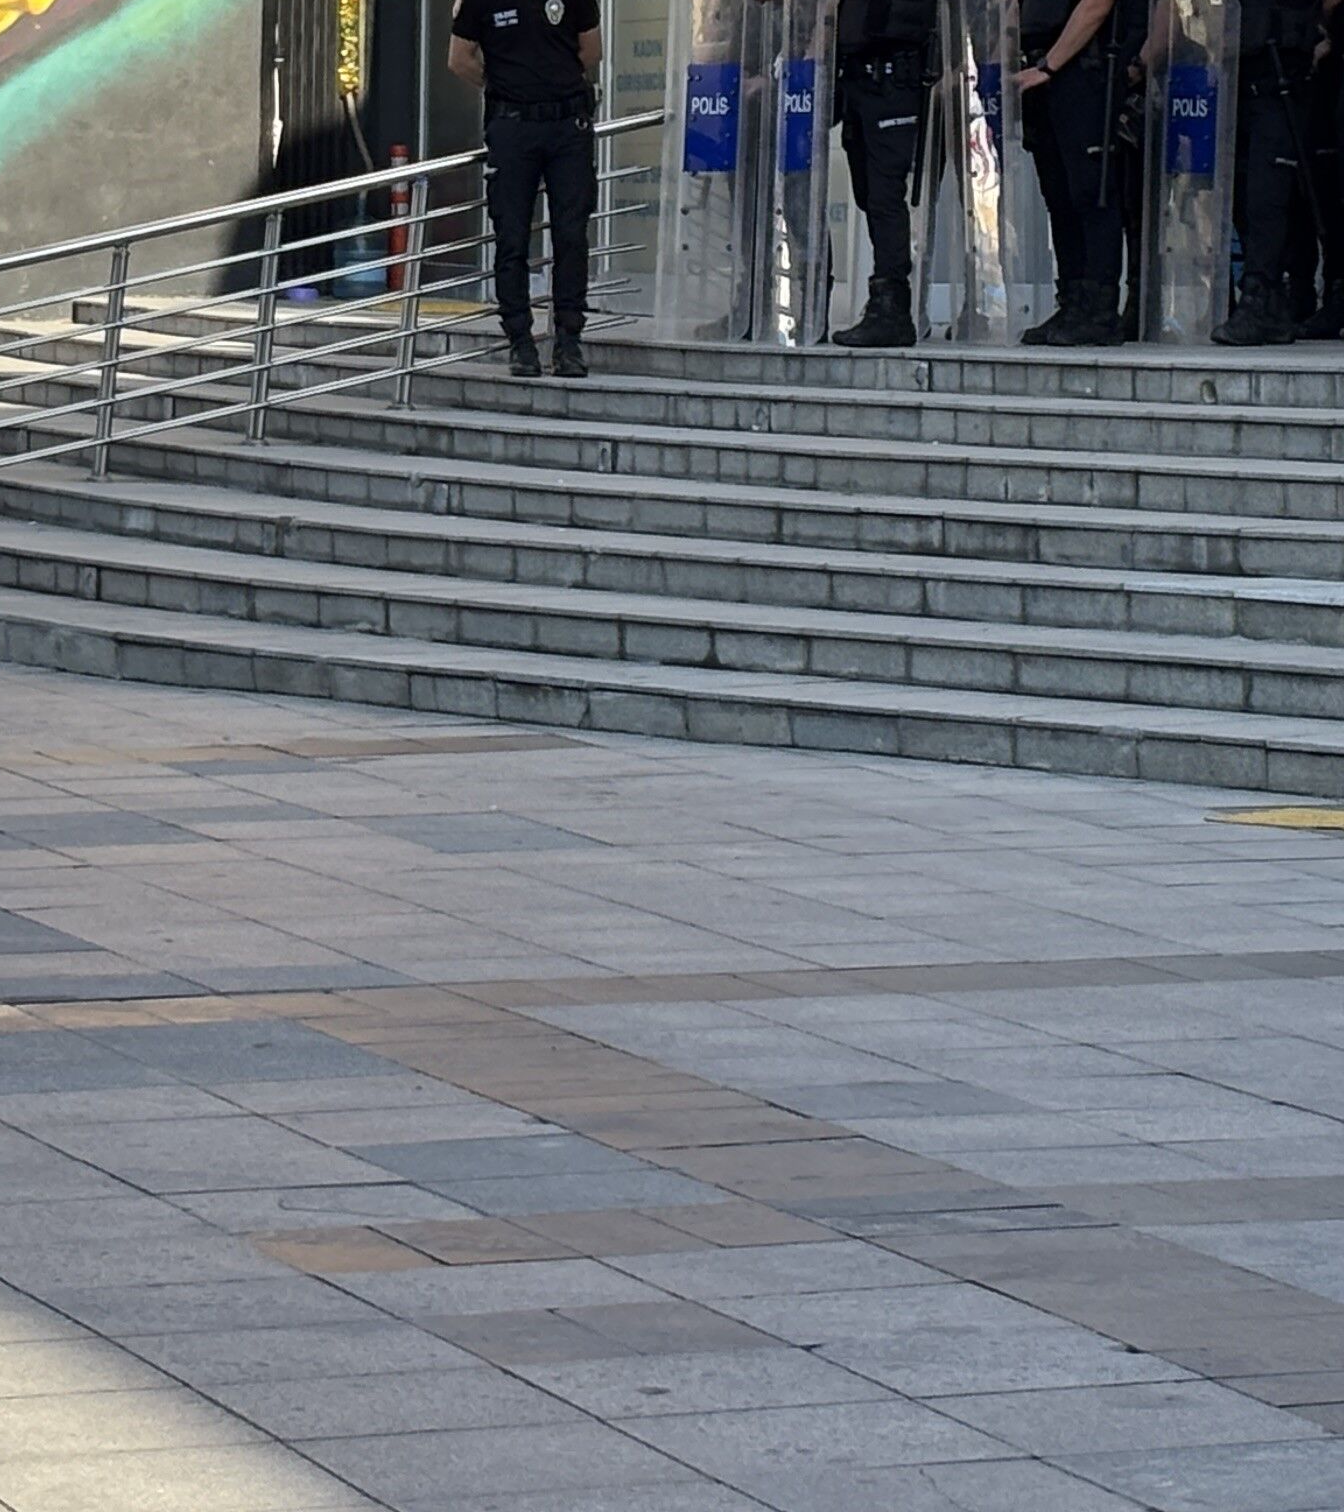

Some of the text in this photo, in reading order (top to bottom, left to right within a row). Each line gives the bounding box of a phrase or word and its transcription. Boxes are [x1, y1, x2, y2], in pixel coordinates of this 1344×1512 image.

[691, 93, 730, 116] POLİS
[784, 93, 812, 114] POLİS
[1172, 94, 1208, 117] POLİS
